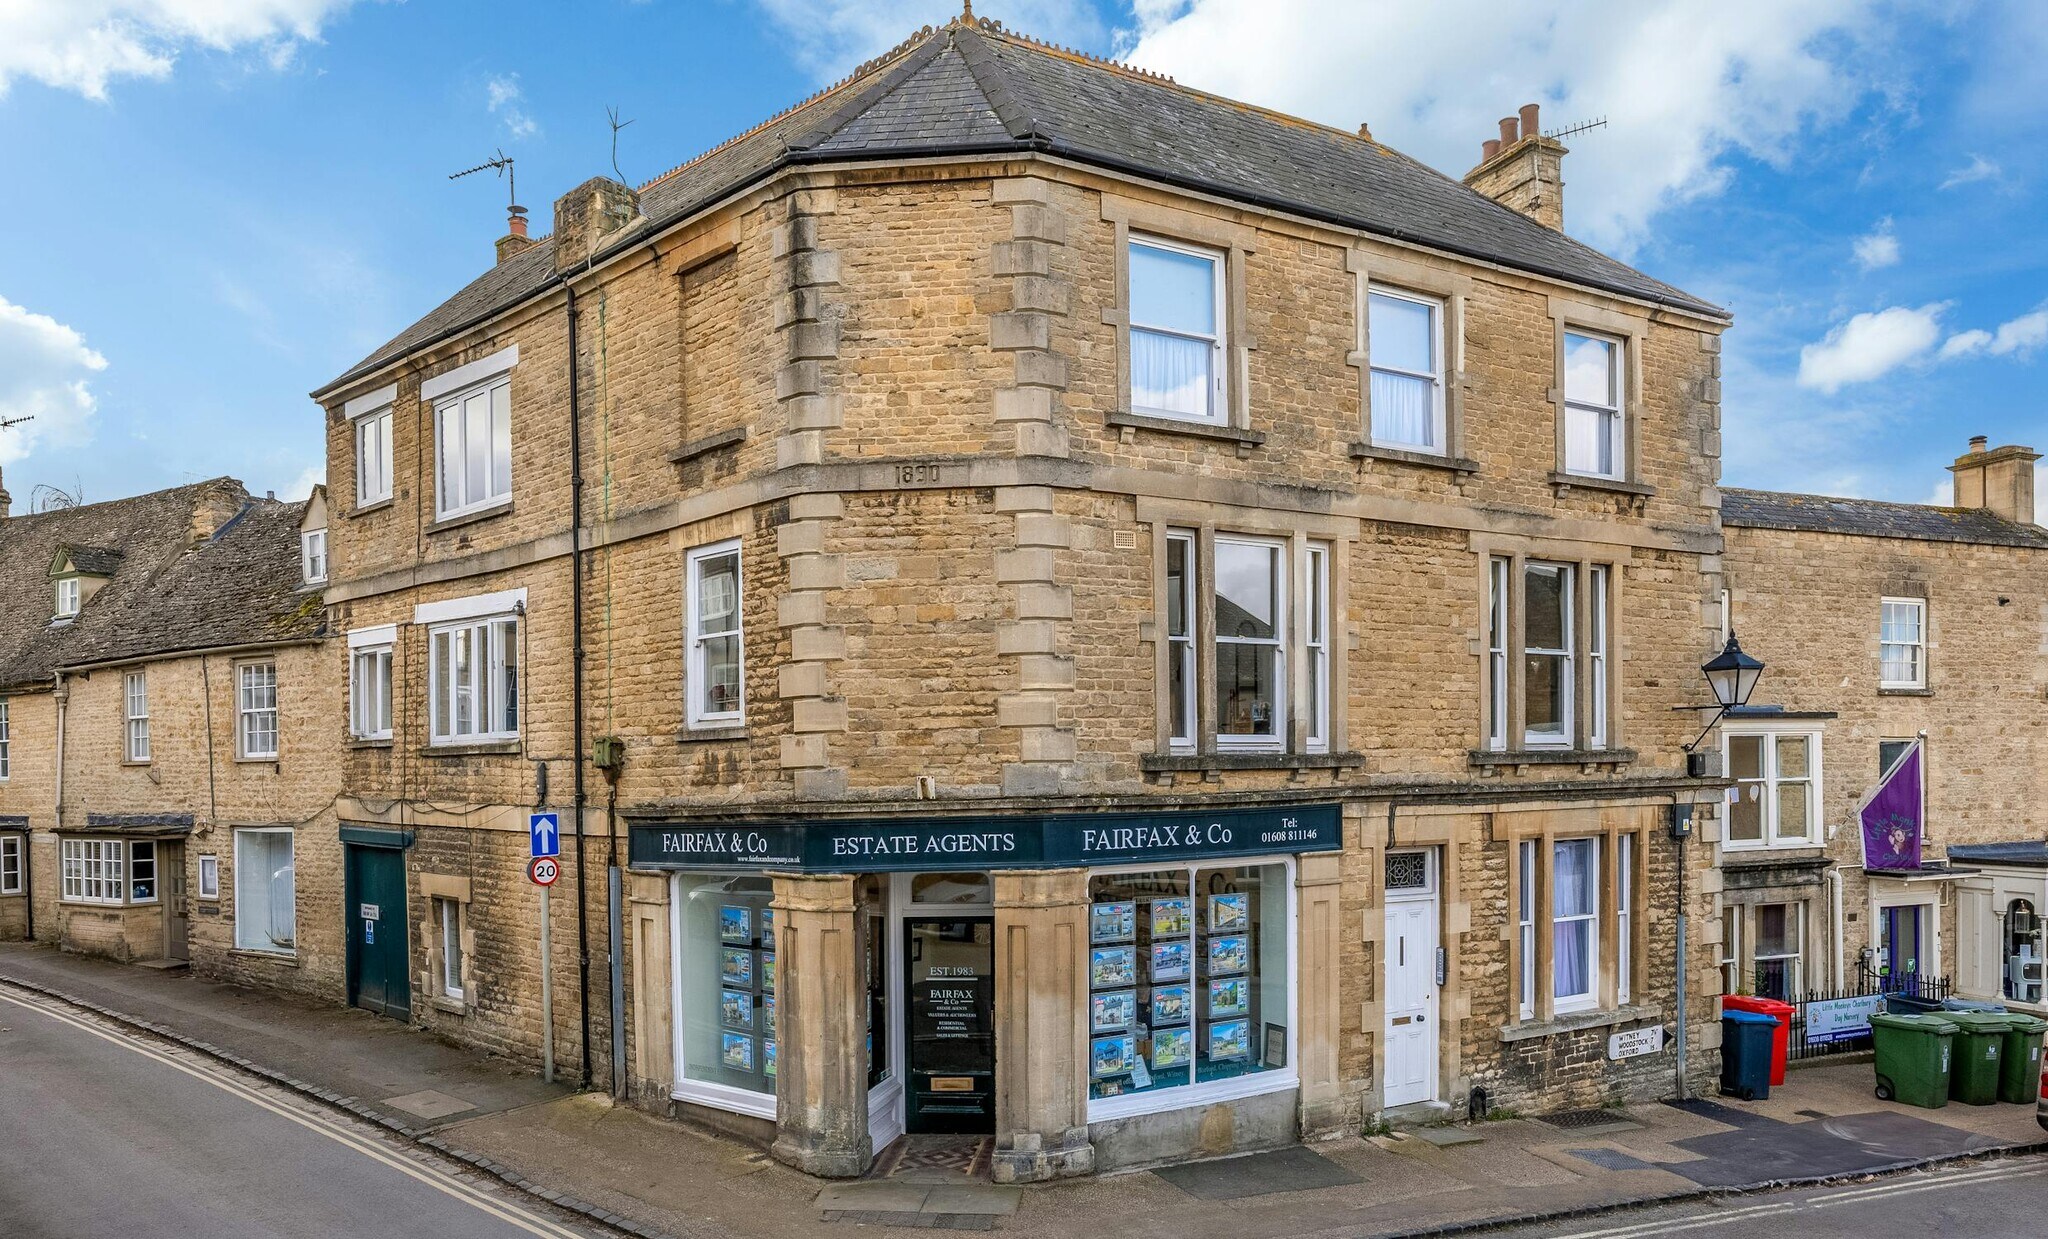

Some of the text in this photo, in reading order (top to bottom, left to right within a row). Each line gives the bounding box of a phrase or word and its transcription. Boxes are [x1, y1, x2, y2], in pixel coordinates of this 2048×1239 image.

[1281, 817, 1298, 828] Tel:
[1082, 823, 1233, 851] FAIRFAX & Co
[1261, 829, 1317, 843] 01608 811146
[662, 832, 767, 853] FAIRFAX & Co
[832, 833, 1015, 856] ESTATE AGENTS
[536, 865, 556, 877] 20
[930, 966, 974, 976] EST.1983
[930, 989, 973, 999] FAIRFAX
[1834, 1013, 1843, 1024] Day
[1617, 1031, 1640, 1041] WITNEY
[1618, 1038, 1649, 1049] WOODSTOCK
[1618, 1047, 1640, 1057] OXFORD
